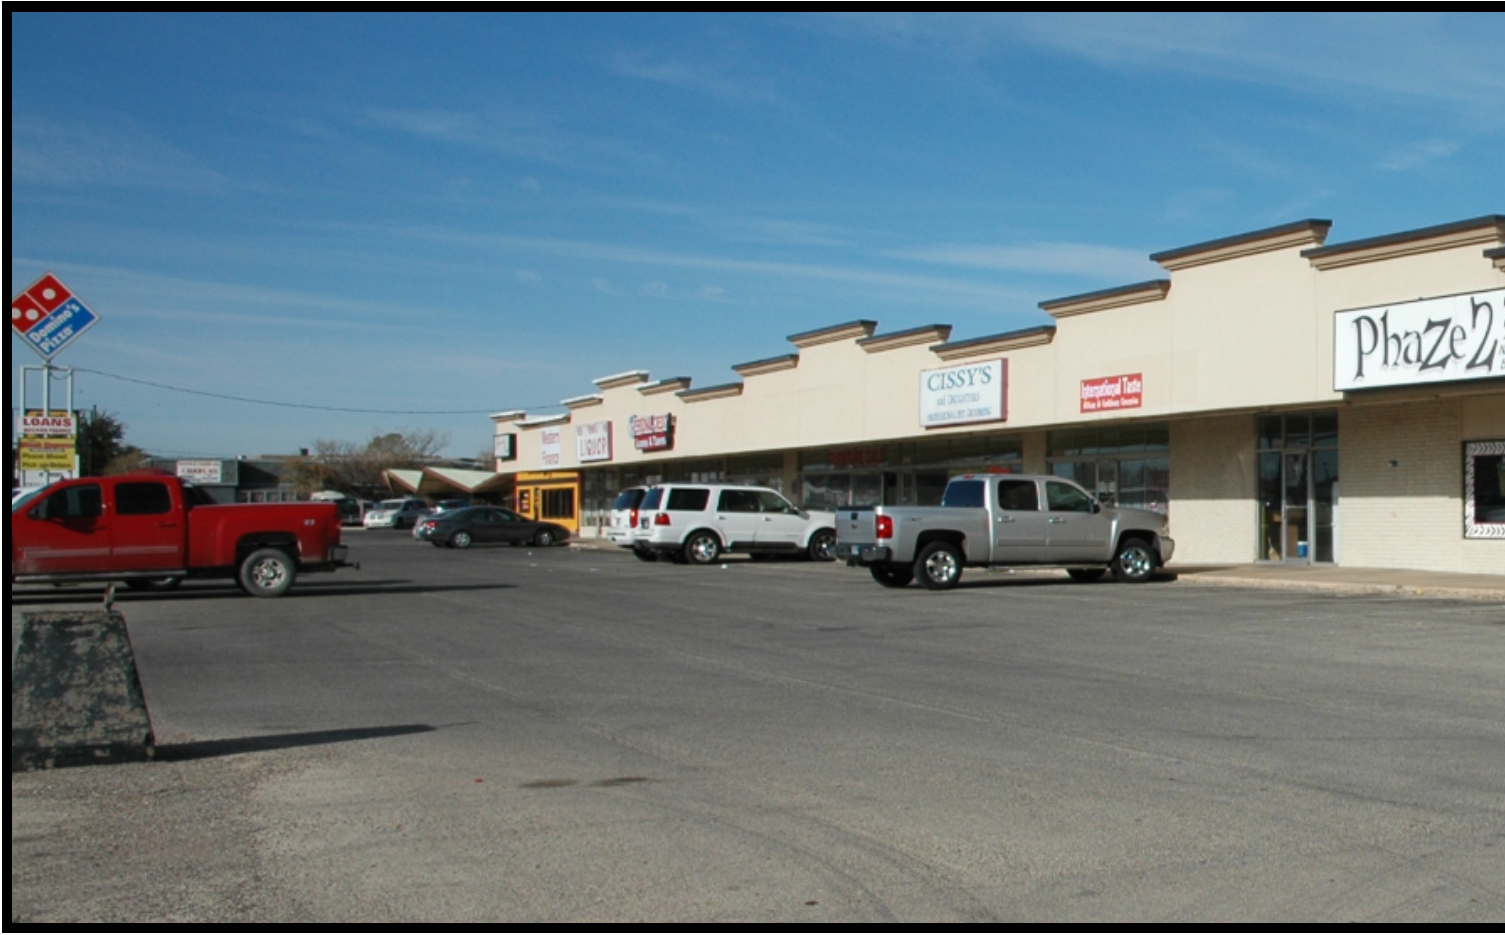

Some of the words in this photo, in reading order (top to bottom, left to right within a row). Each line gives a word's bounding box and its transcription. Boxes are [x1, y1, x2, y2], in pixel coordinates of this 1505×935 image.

[28, 303, 80, 343] Domino's
[1464, 296, 1498, 371] 2
[39, 325, 73, 352] Pizza
[927, 365, 992, 391] CISSY'S
[1081, 378, 1121, 399] International
[1121, 376, 1142, 395] Taste
[23, 418, 72, 426] LOANS
[580, 436, 607, 456] LIQUOR
